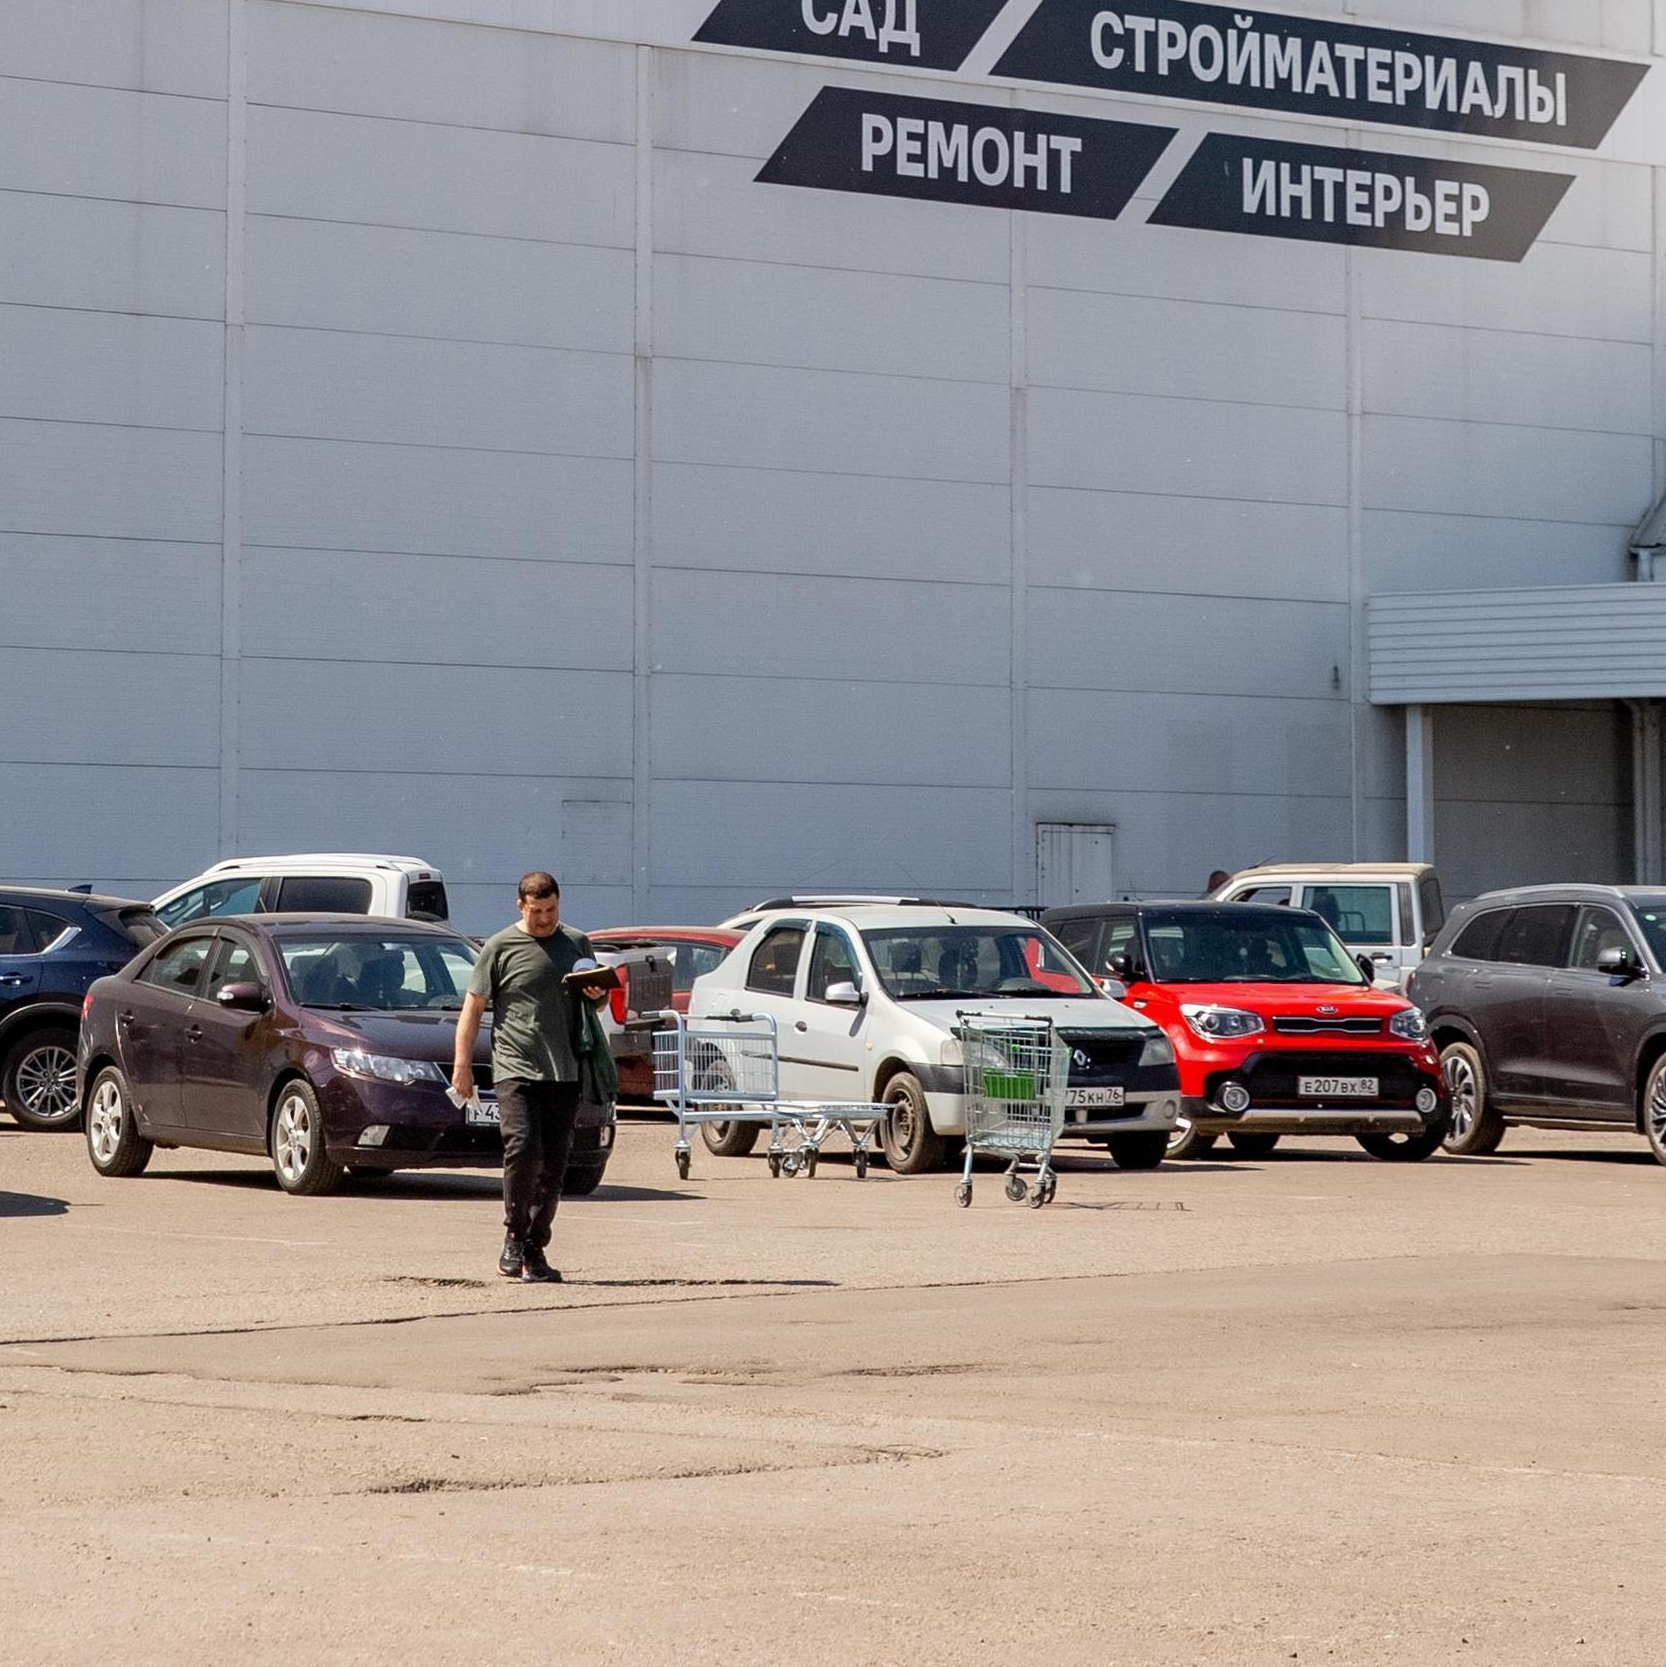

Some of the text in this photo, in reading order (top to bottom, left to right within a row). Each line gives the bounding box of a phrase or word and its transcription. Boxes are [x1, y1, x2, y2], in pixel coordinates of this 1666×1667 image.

[1090, 11, 1567, 126] СТРОЙМАТЕРИАЛЫ
[862, 113, 1082, 194] РЕМОНТ
[1242, 157, 1490, 236] ИНТЕРЬЕР
[1066, 1090, 1104, 1104] 75КН
